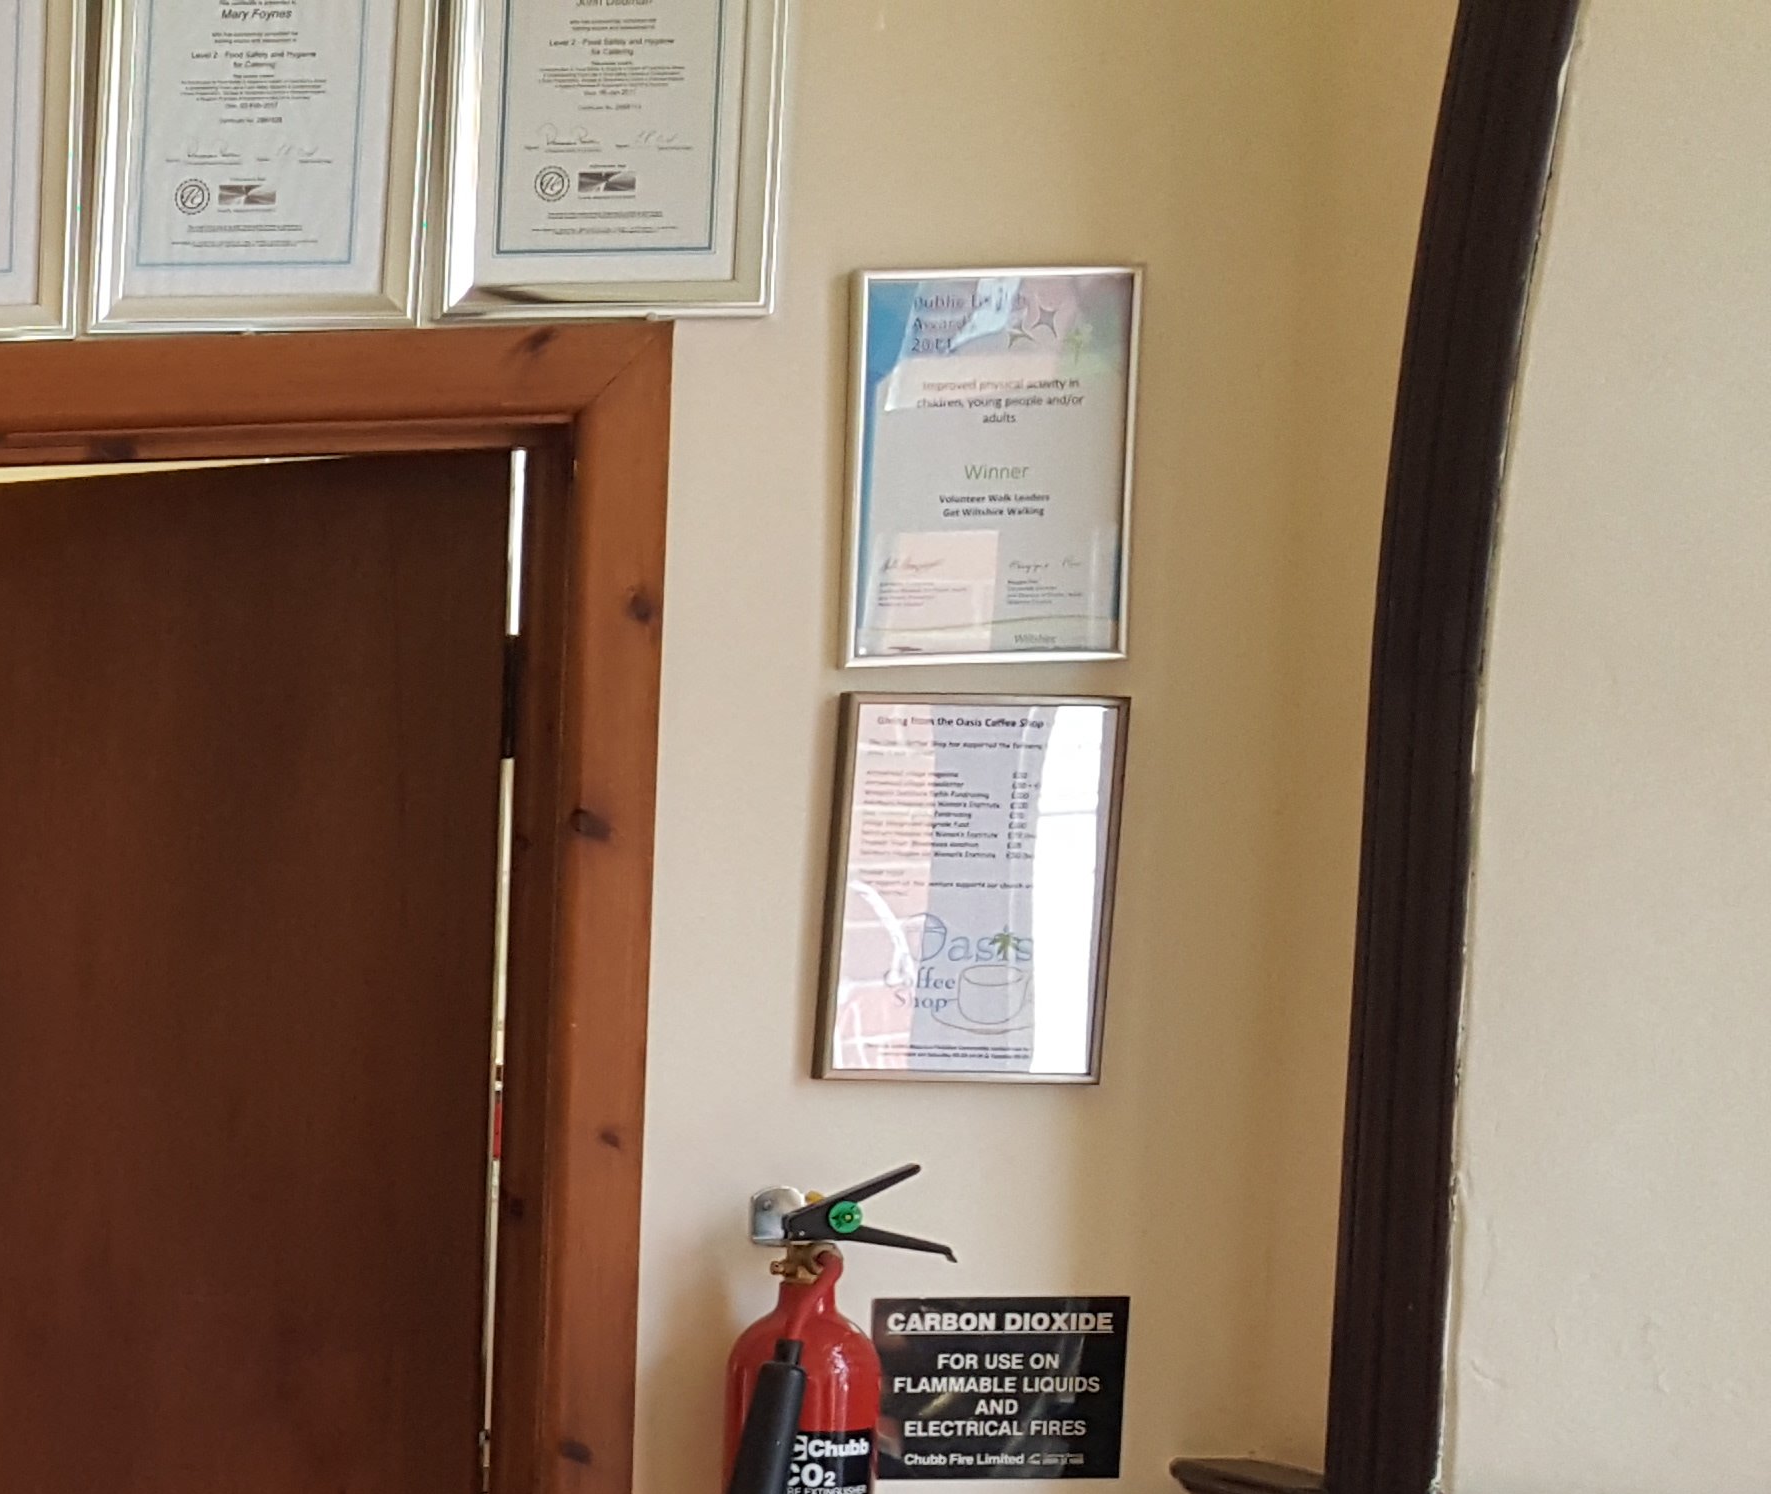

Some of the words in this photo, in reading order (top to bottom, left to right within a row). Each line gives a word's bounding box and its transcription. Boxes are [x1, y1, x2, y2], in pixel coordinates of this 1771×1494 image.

[222, 10, 248, 19] Mary
[979, 378, 1025, 392] physical
[1028, 377, 1063, 392] activity
[967, 396, 1002, 411] young
[1005, 396, 1042, 410] people
[1046, 394, 1084, 408] and/or
[982, 412, 1016, 424] adults
[965, 464, 1029, 481] Winner
[956, 717, 982, 728] Oasis
[985, 718, 1016, 729] Coffee
[887, 1313, 998, 1331] CARBON
[1004, 1313, 1114, 1331] DIOXIDE
[937, 1354, 979, 1369] FOR
[984, 1354, 1023, 1369] USE
[1030, 1354, 1059, 1369] ON
[893, 1377, 1016, 1393] FLAMMABLE
[1023, 1377, 1100, 1394] LIQUIDS
[974, 1400, 1018, 1415] AND
[904, 1421, 1022, 1437] ELECTRICAL
[1029, 1421, 1086, 1437] FIRES
[809, 1438, 870, 1458] Chubb
[904, 1453, 947, 1466] Chubb
[949, 1453, 974, 1466] Fire
[976, 1453, 1024, 1465] Limited
